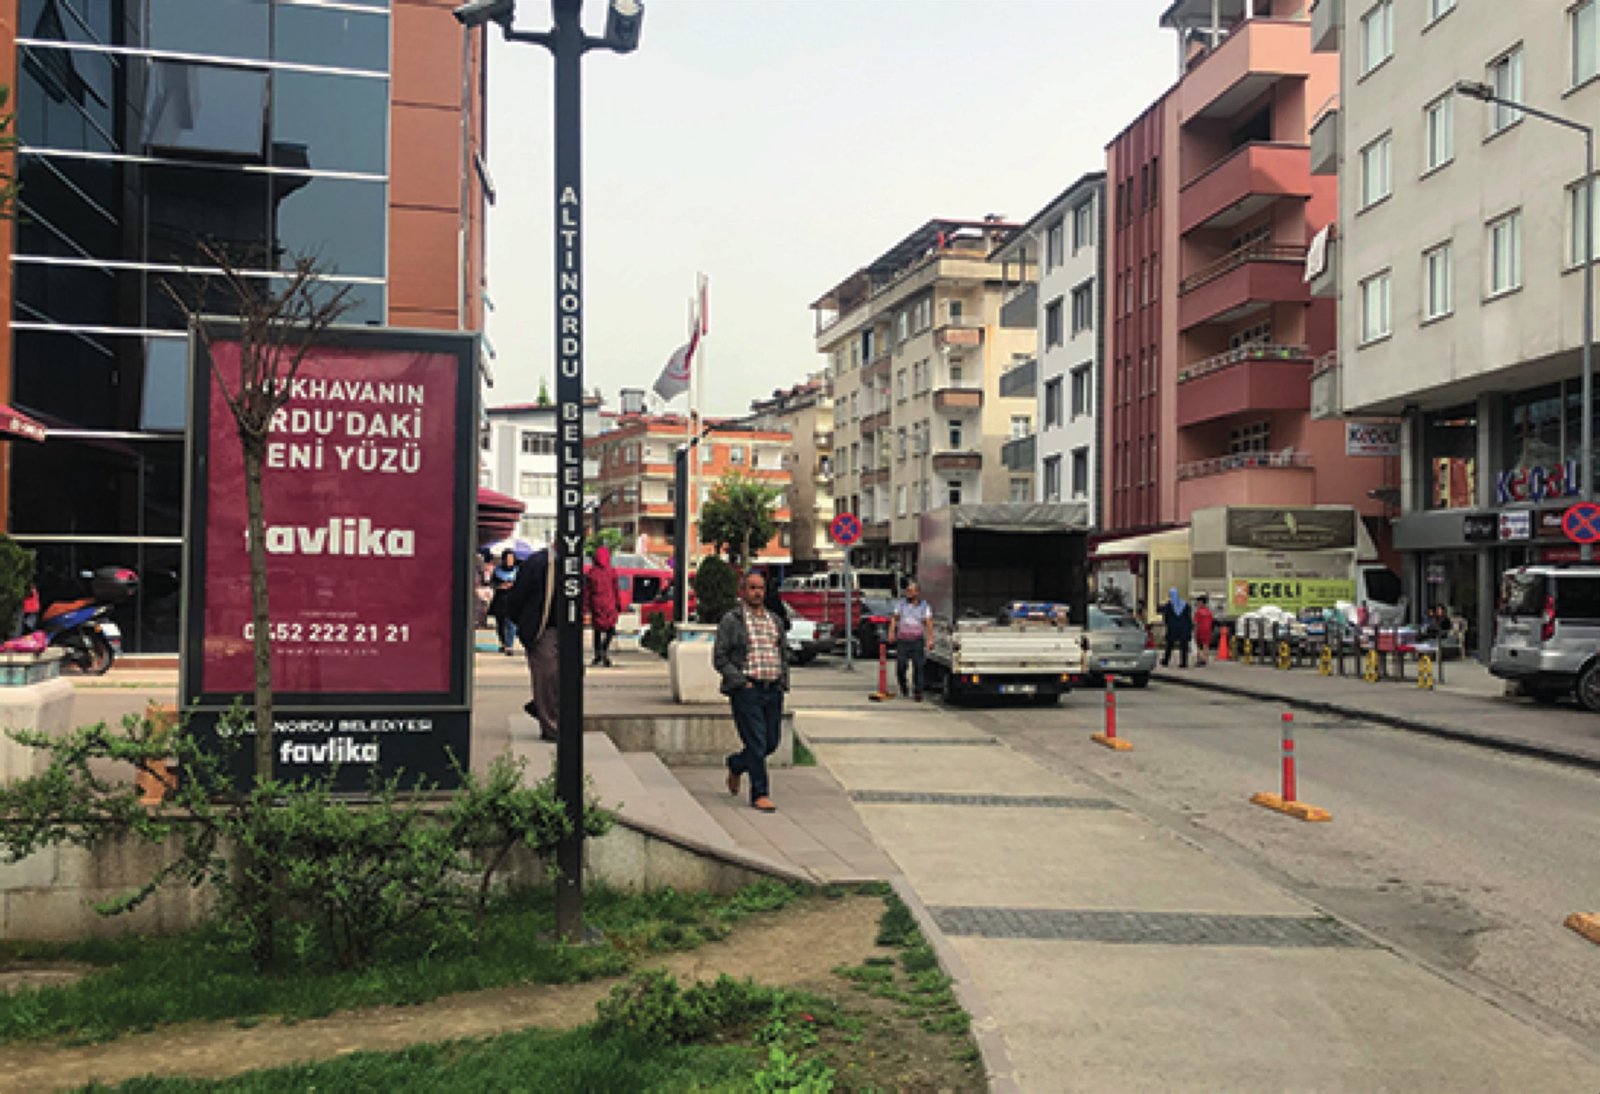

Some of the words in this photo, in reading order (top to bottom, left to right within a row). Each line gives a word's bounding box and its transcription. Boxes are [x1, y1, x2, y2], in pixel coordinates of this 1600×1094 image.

[559, 186, 578, 377] ALTINORDU
[268, 407, 421, 438] RDU'DAKİ
[267, 439, 323, 470] ENİ
[335, 440, 421, 473] YÜZÜ
[309, 623, 348, 642] 222
[354, 623, 378, 642] 21
[385, 623, 410, 642] 21
[280, 737, 380, 764] favlika
